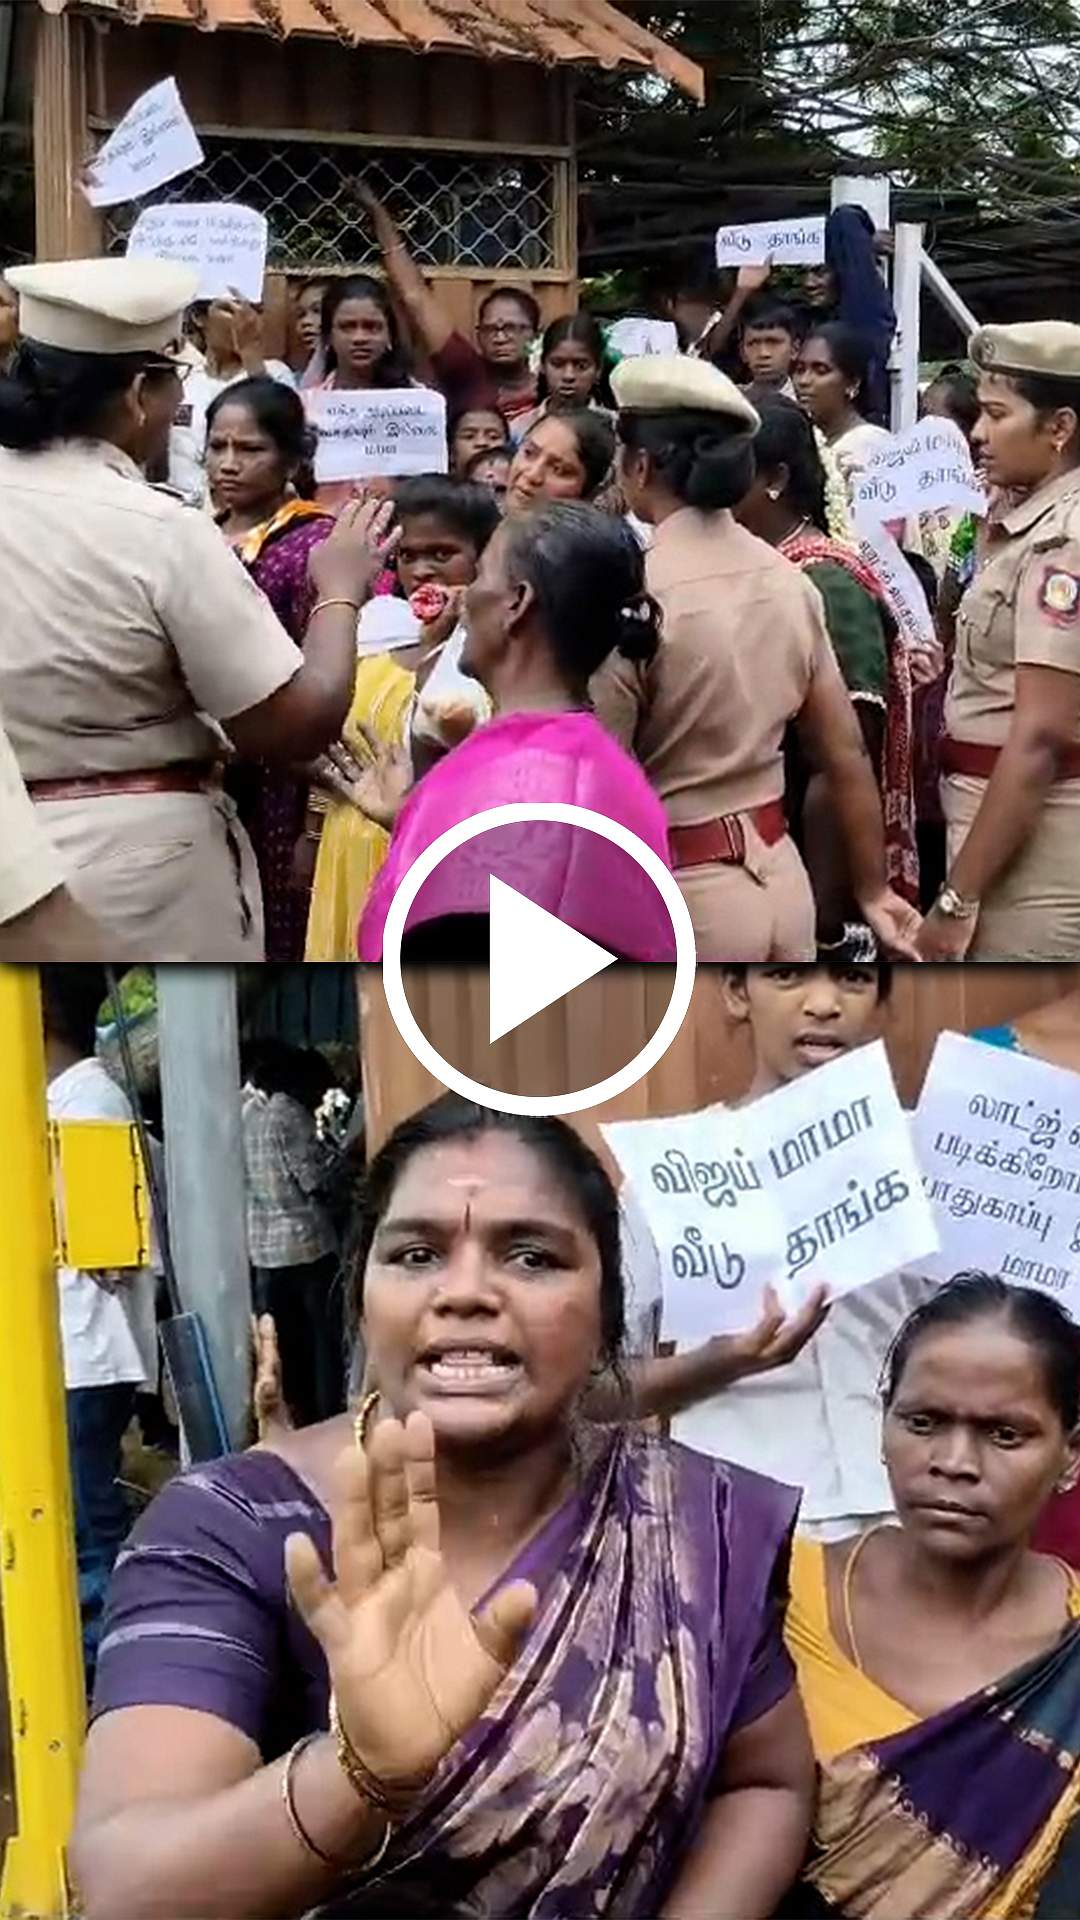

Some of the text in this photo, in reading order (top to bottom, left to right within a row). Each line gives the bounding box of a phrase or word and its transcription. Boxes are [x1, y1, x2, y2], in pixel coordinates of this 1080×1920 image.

[859, 475, 896, 503] வீடு
[968, 1094, 1062, 1150] லாட்ஜ்
[651, 1095, 874, 1208] விஜய் மாமா
[672, 1169, 910, 1290] வீடு தாங்க
[1001, 1253, 1071, 1290] மாமா
